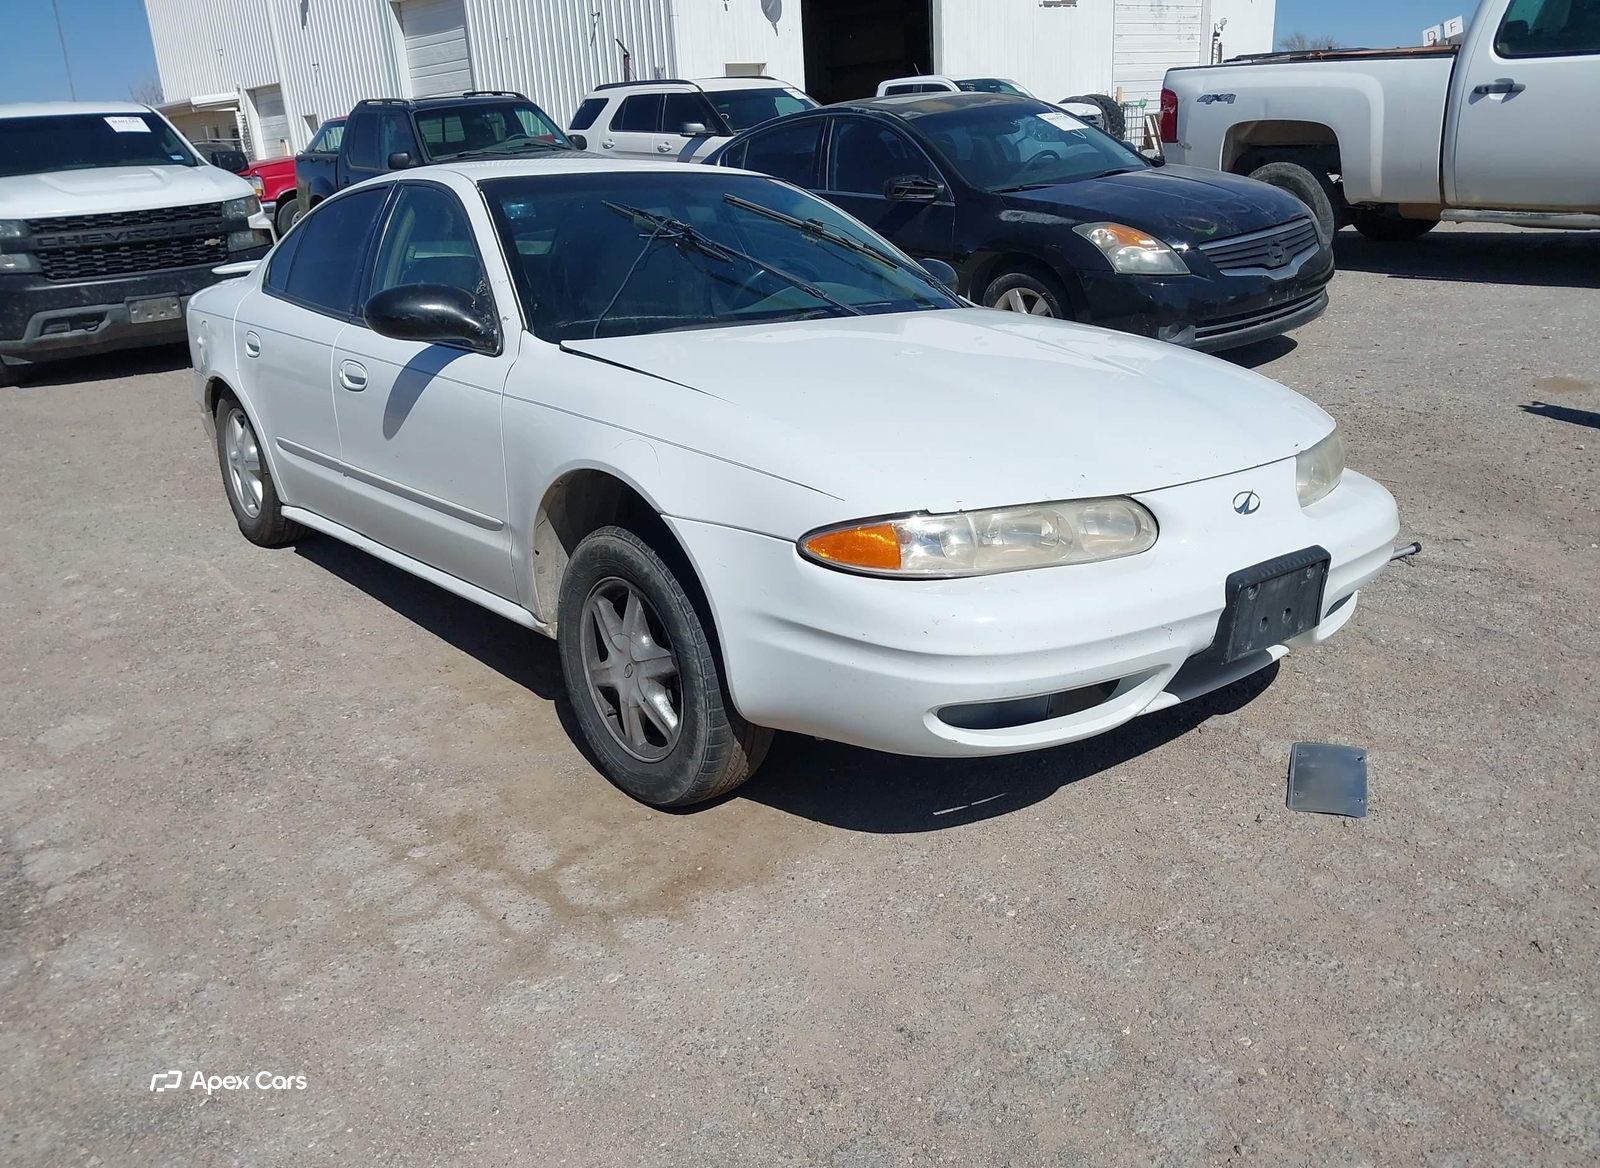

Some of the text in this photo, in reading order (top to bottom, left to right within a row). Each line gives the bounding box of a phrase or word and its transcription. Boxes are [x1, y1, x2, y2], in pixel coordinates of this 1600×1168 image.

[1449, 21, 1456, 33] F
[1427, 30, 1436, 42] D
[37, 221, 223, 247] CHEVROLET
